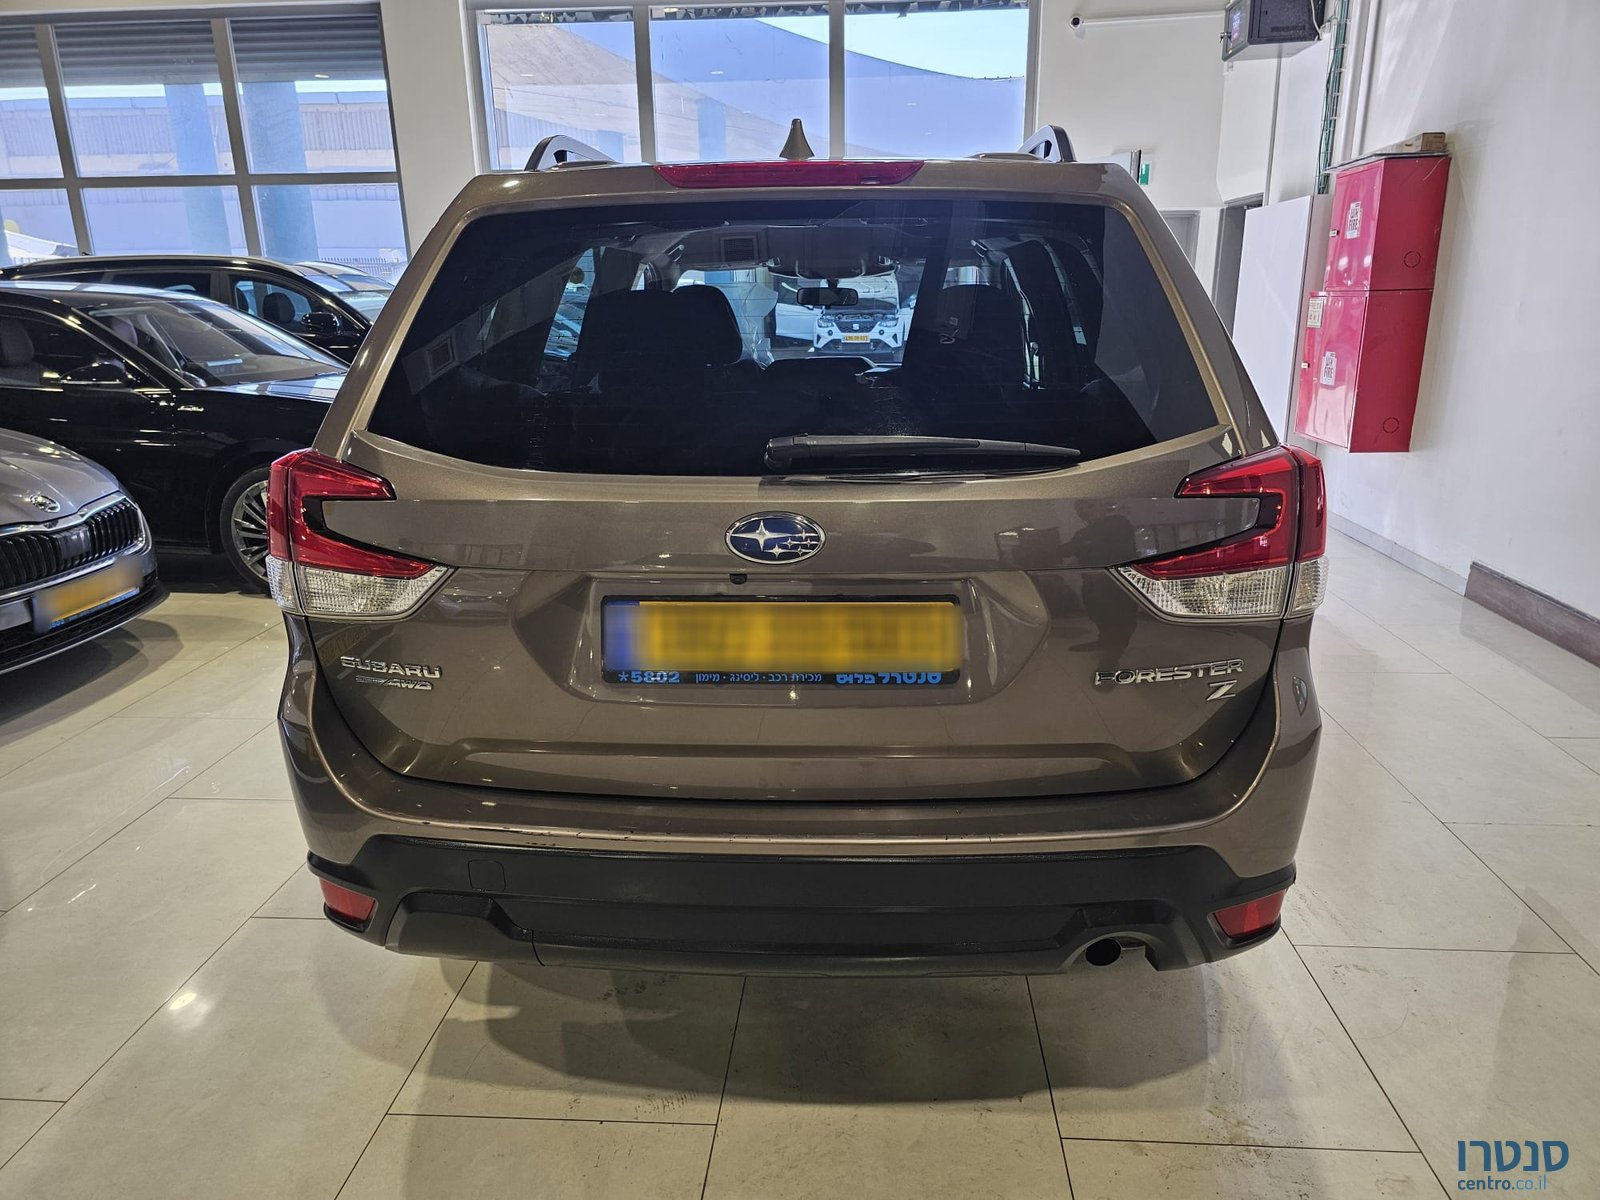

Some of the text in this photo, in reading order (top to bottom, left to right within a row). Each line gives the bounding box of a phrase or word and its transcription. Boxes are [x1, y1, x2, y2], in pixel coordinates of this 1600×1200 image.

[340, 656, 442, 679] SUBARU
[1095, 658, 1245, 686] FORESTER
[695, 673, 720, 684] מימון
[729, 671, 760, 682] ליסינג
[768, 673, 788, 682] רכב
[791, 673, 822, 683] מכירת
[835, 673, 876, 685] פלוס
[878, 671, 942, 684] סנטרל
[384, 678, 433, 691] AWD
[1206, 679, 1238, 701] Z
